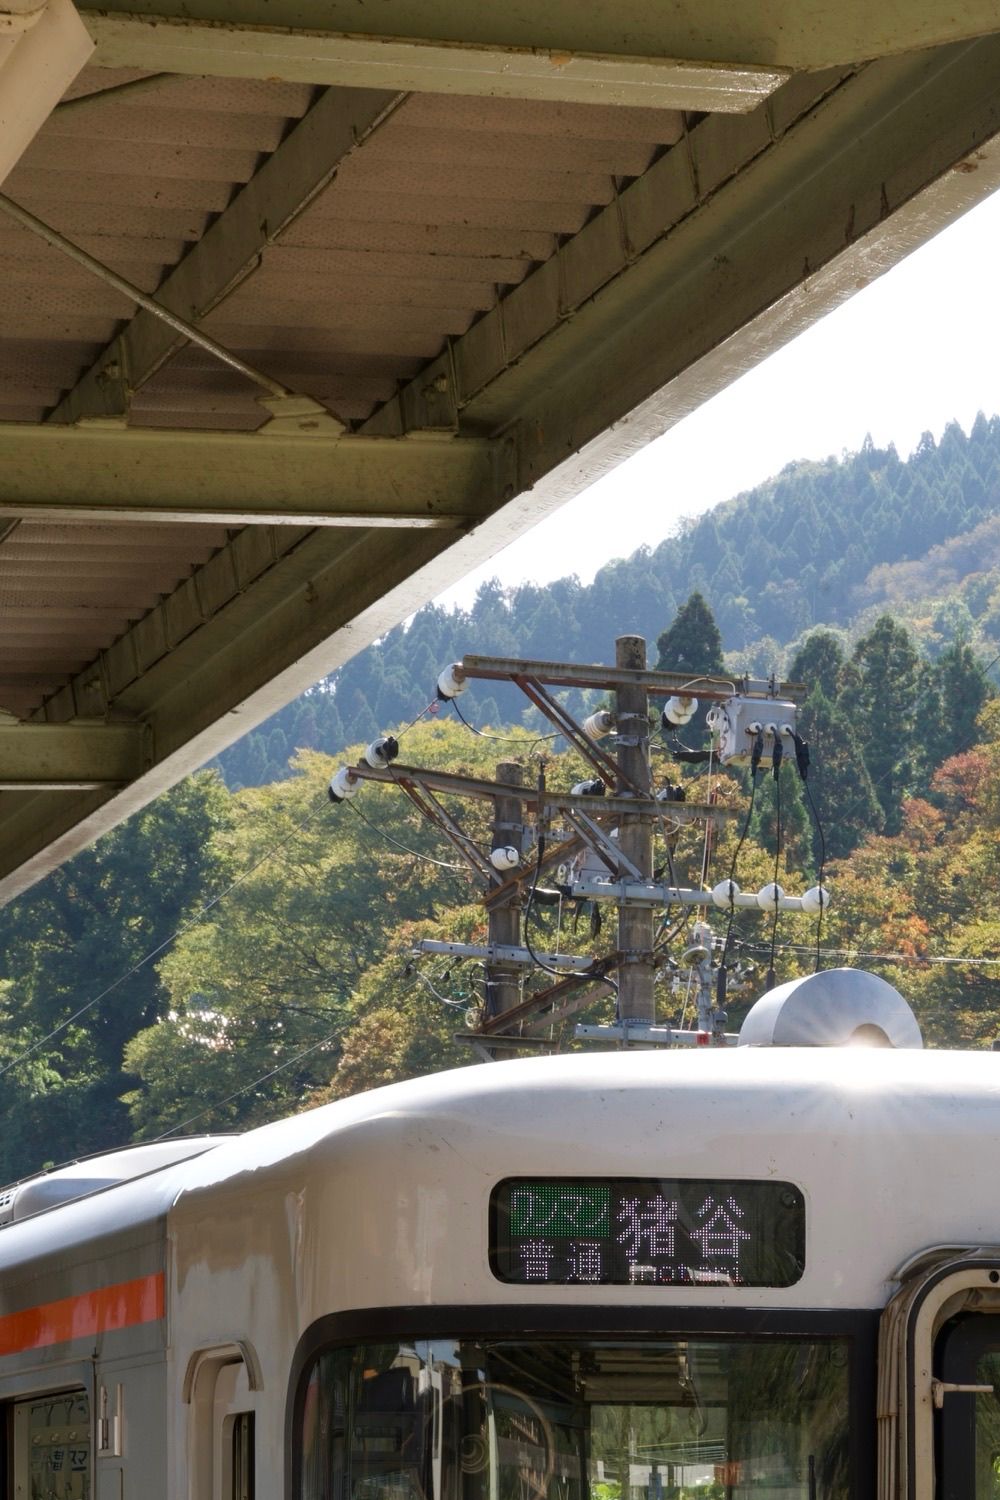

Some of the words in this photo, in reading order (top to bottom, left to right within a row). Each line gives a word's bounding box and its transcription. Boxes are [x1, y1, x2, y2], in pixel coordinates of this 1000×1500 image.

[511, 1190, 608, 1231] ワンマン
[616, 1194, 751, 1258] 猪谷
[519, 1239, 601, 1281] 普通
[628, 1259, 742, 1282] Inotani
